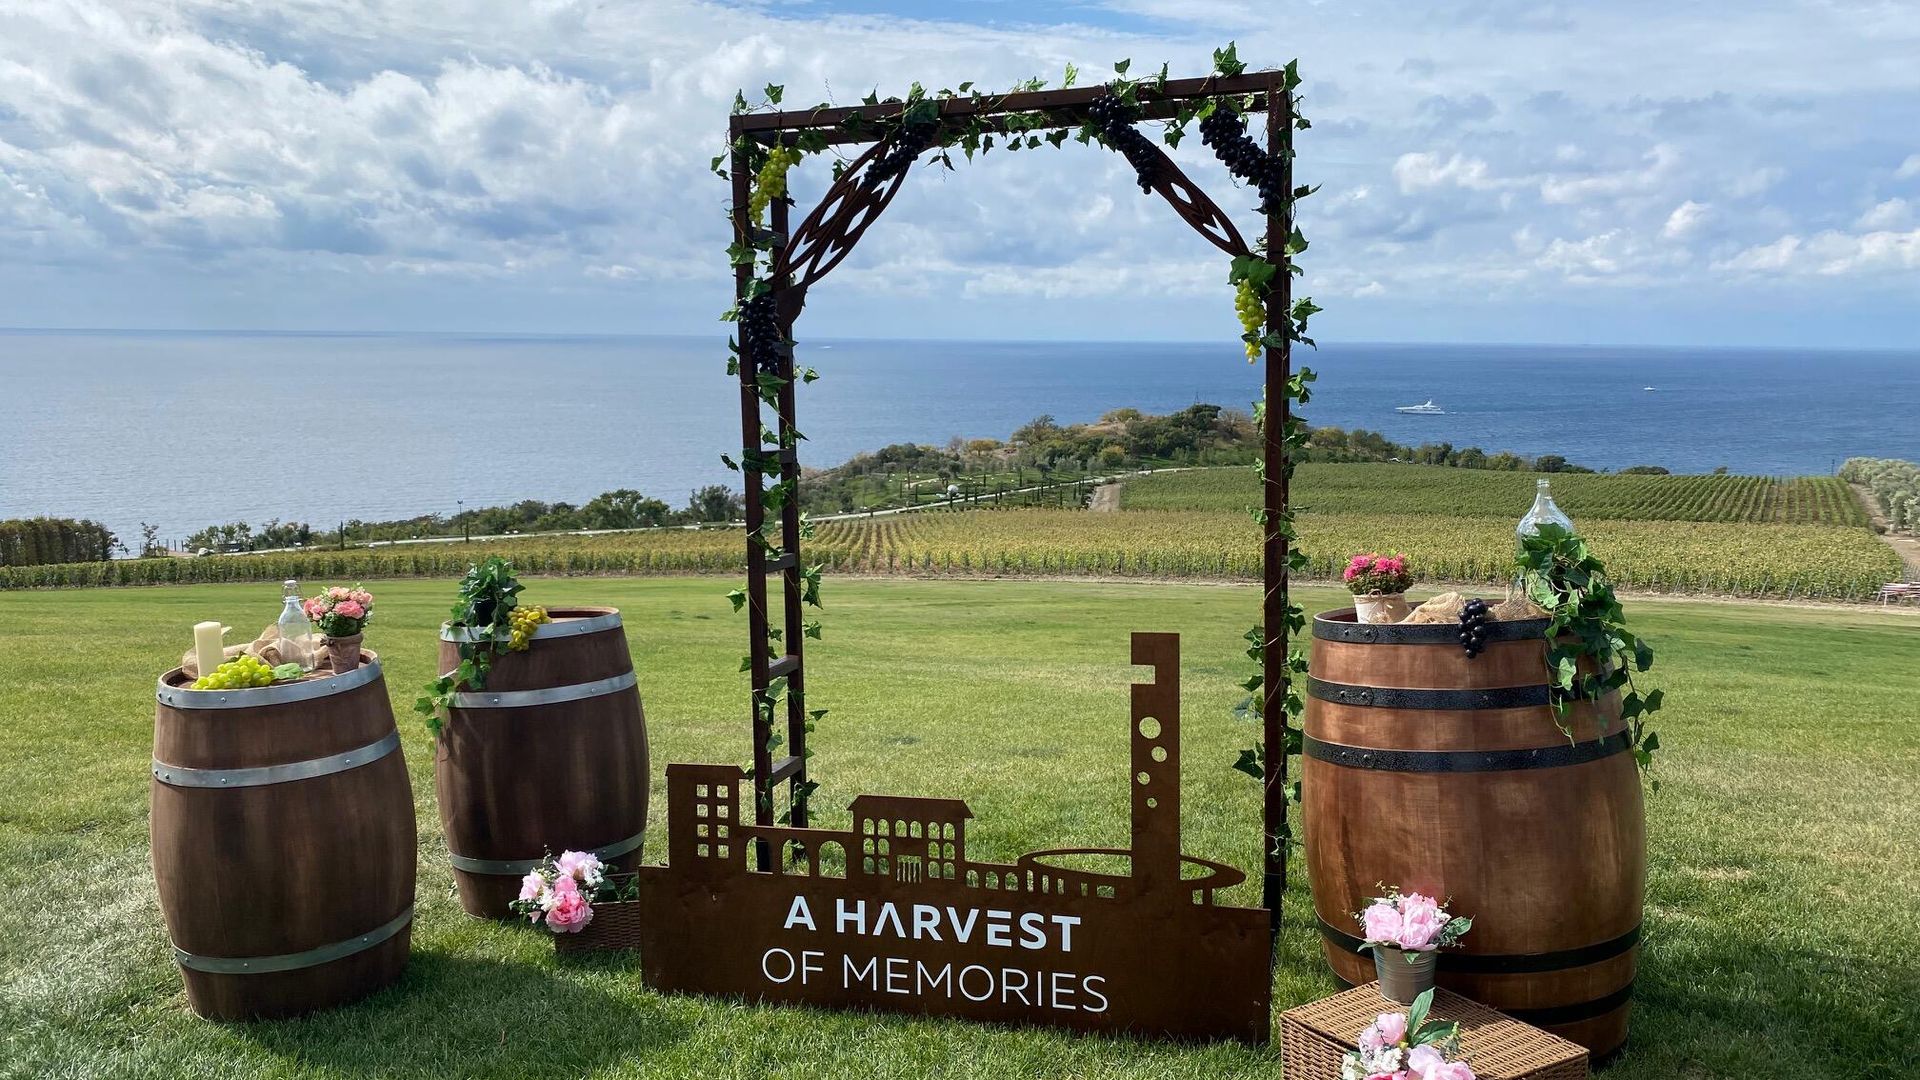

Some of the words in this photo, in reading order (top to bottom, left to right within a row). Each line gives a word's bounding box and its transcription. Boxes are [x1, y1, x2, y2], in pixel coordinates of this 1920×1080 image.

[783, 895, 816, 931] A
[836, 898, 1081, 952] HARVEST
[762, 948, 825, 985] OF
[843, 954, 1108, 1013] MEMORIES
